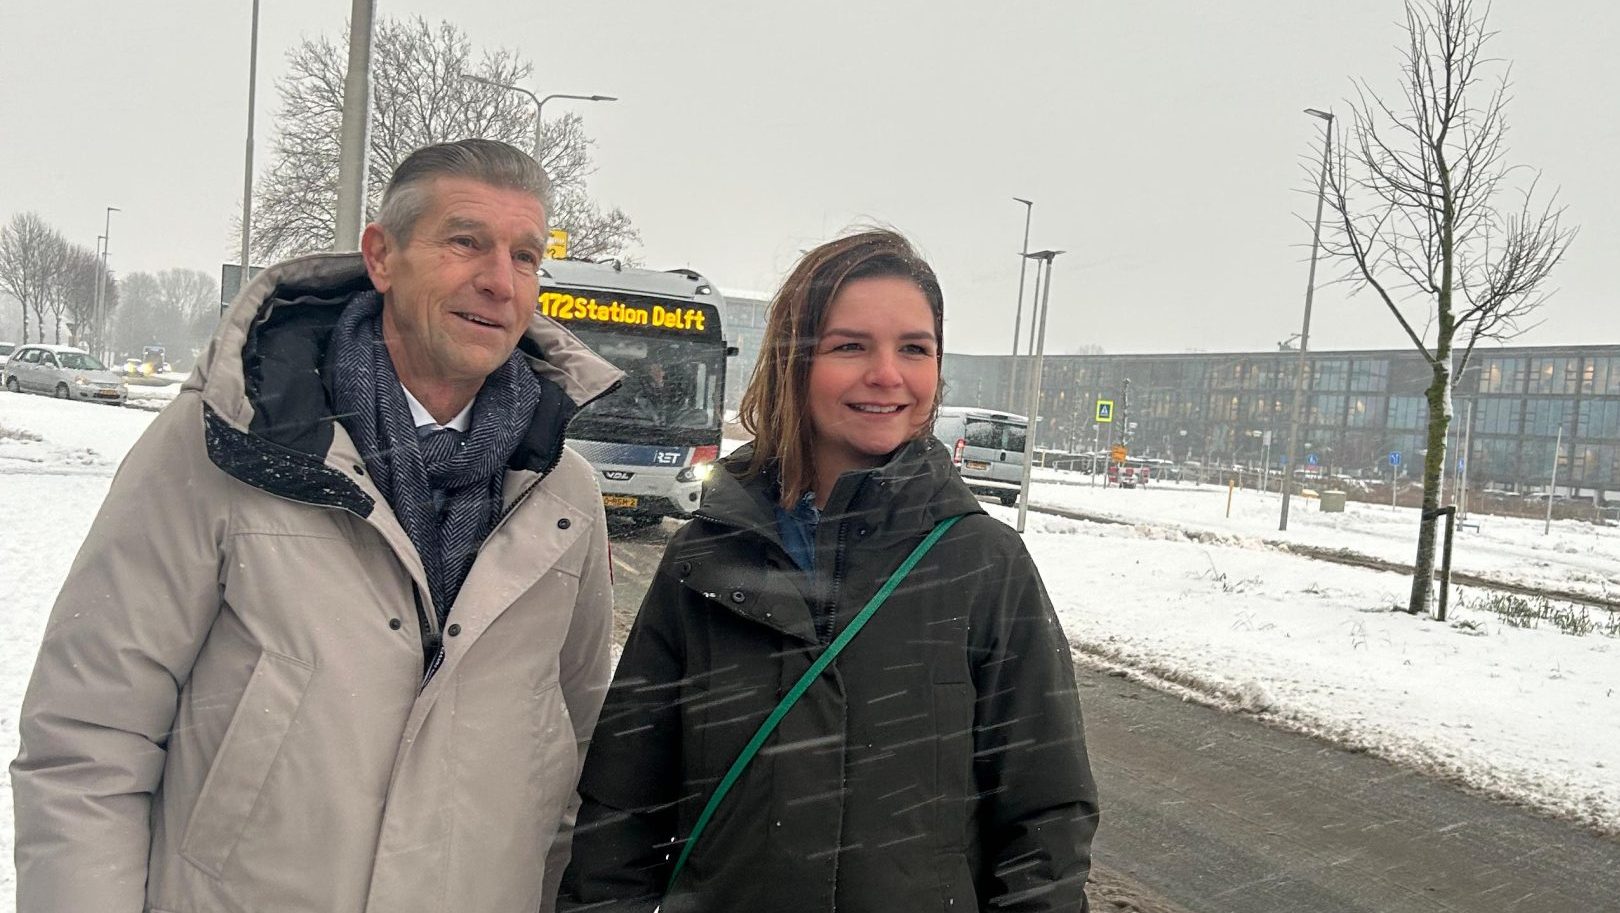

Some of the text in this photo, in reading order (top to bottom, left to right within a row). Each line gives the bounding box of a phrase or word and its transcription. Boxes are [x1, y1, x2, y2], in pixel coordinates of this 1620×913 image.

[538, 292, 705, 331] 172 Station Delft
[653, 450, 681, 464] RET
[606, 471, 629, 480] VDL
